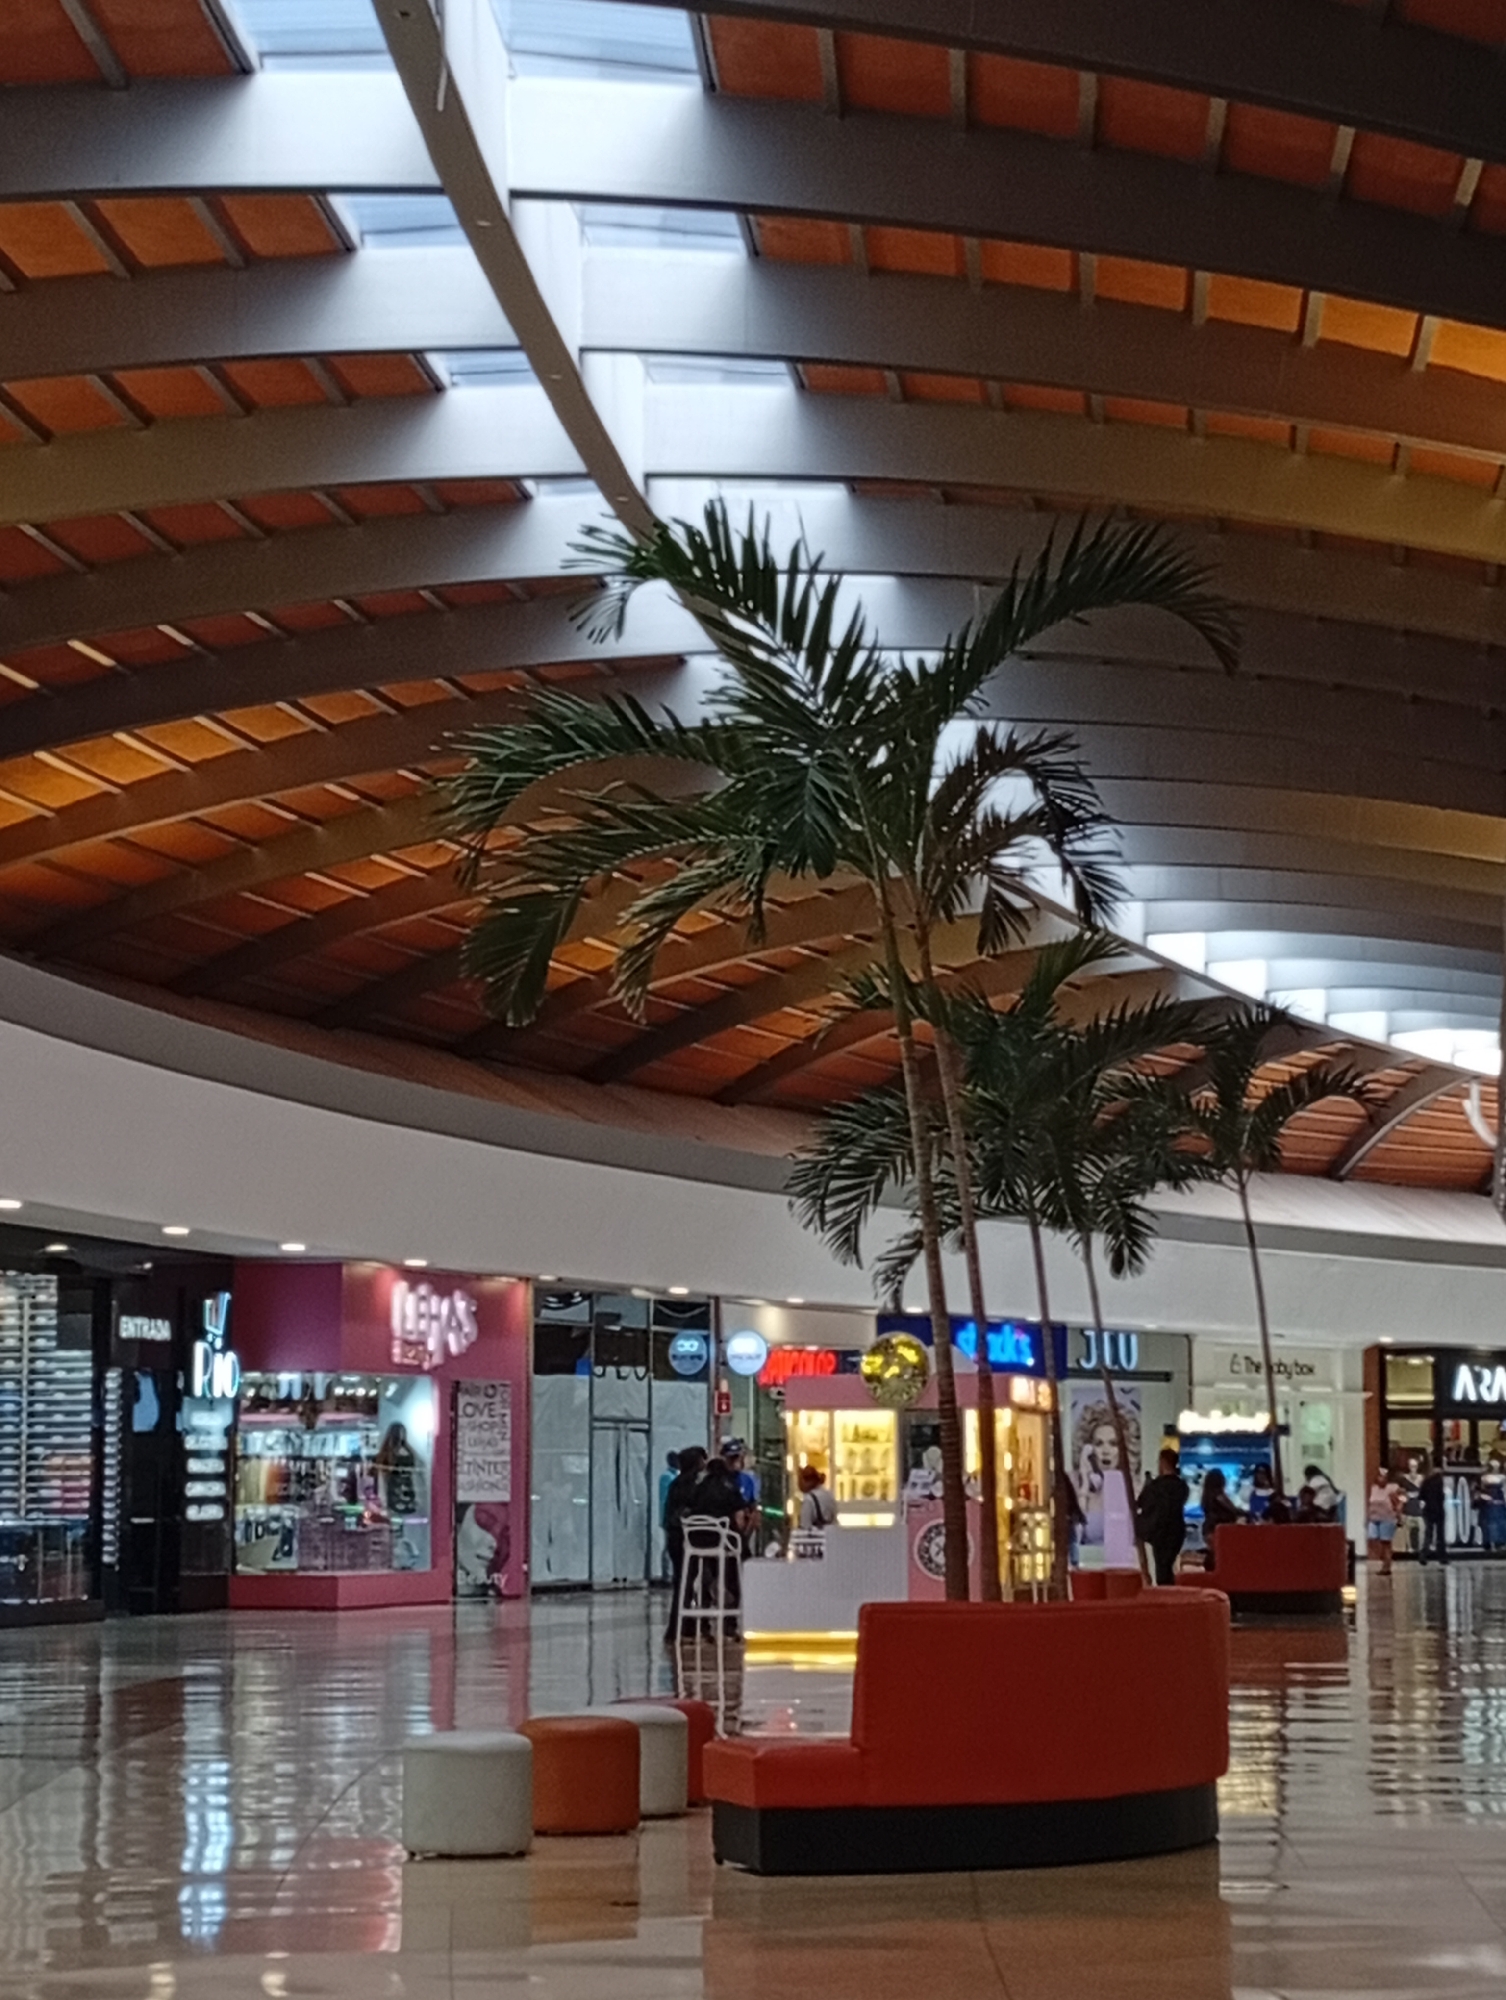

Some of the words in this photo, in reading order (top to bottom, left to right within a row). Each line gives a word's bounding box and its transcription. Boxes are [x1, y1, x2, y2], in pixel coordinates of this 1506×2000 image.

[119, 1314, 172, 1342] ENTRADA
[1243, 1354, 1262, 1375] The
[1294, 1358, 1316, 1376] box
